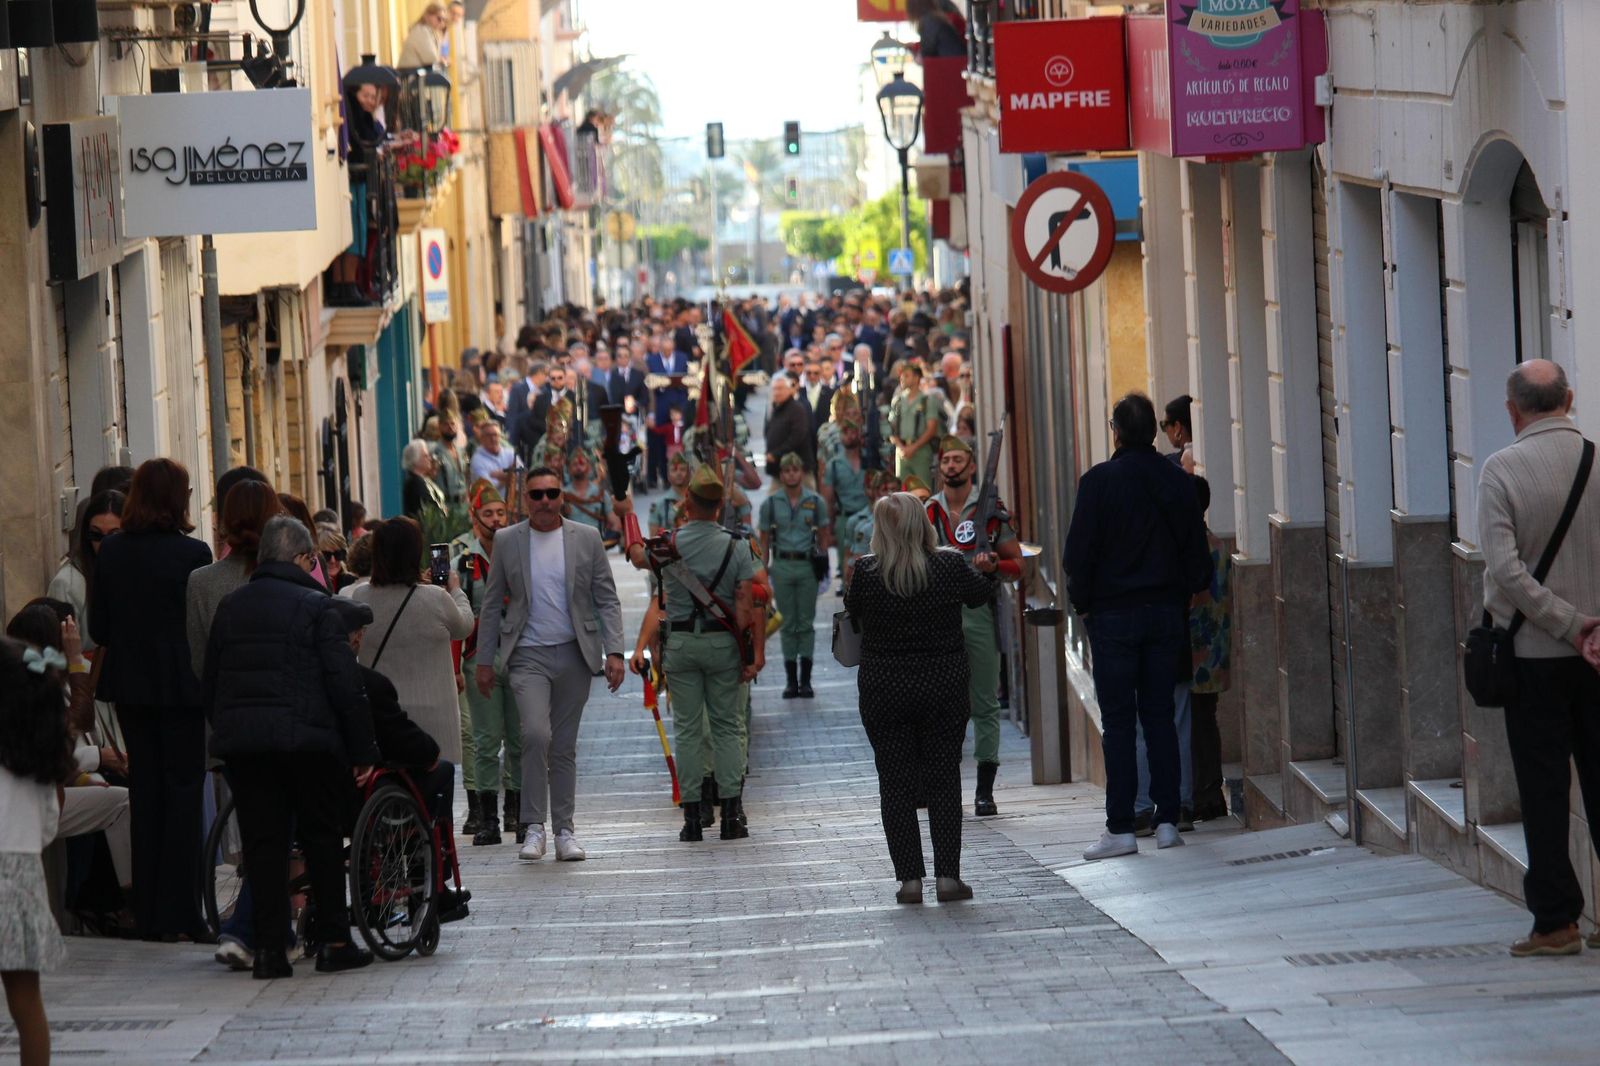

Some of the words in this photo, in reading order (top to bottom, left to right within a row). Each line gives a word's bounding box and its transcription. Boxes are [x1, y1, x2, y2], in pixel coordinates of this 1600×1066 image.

[1208, 0, 1260, 12] MOYA
[1201, 16, 1267, 32] VARIEDADES
[1186, 78, 1235, 96] ARTÍCULOS
[1239, 78, 1249, 93] DE
[1253, 75, 1289, 92] REGALO
[1010, 90, 1110, 111] MAPFRE
[1186, 106, 1291, 127] MULTIPRECIO
